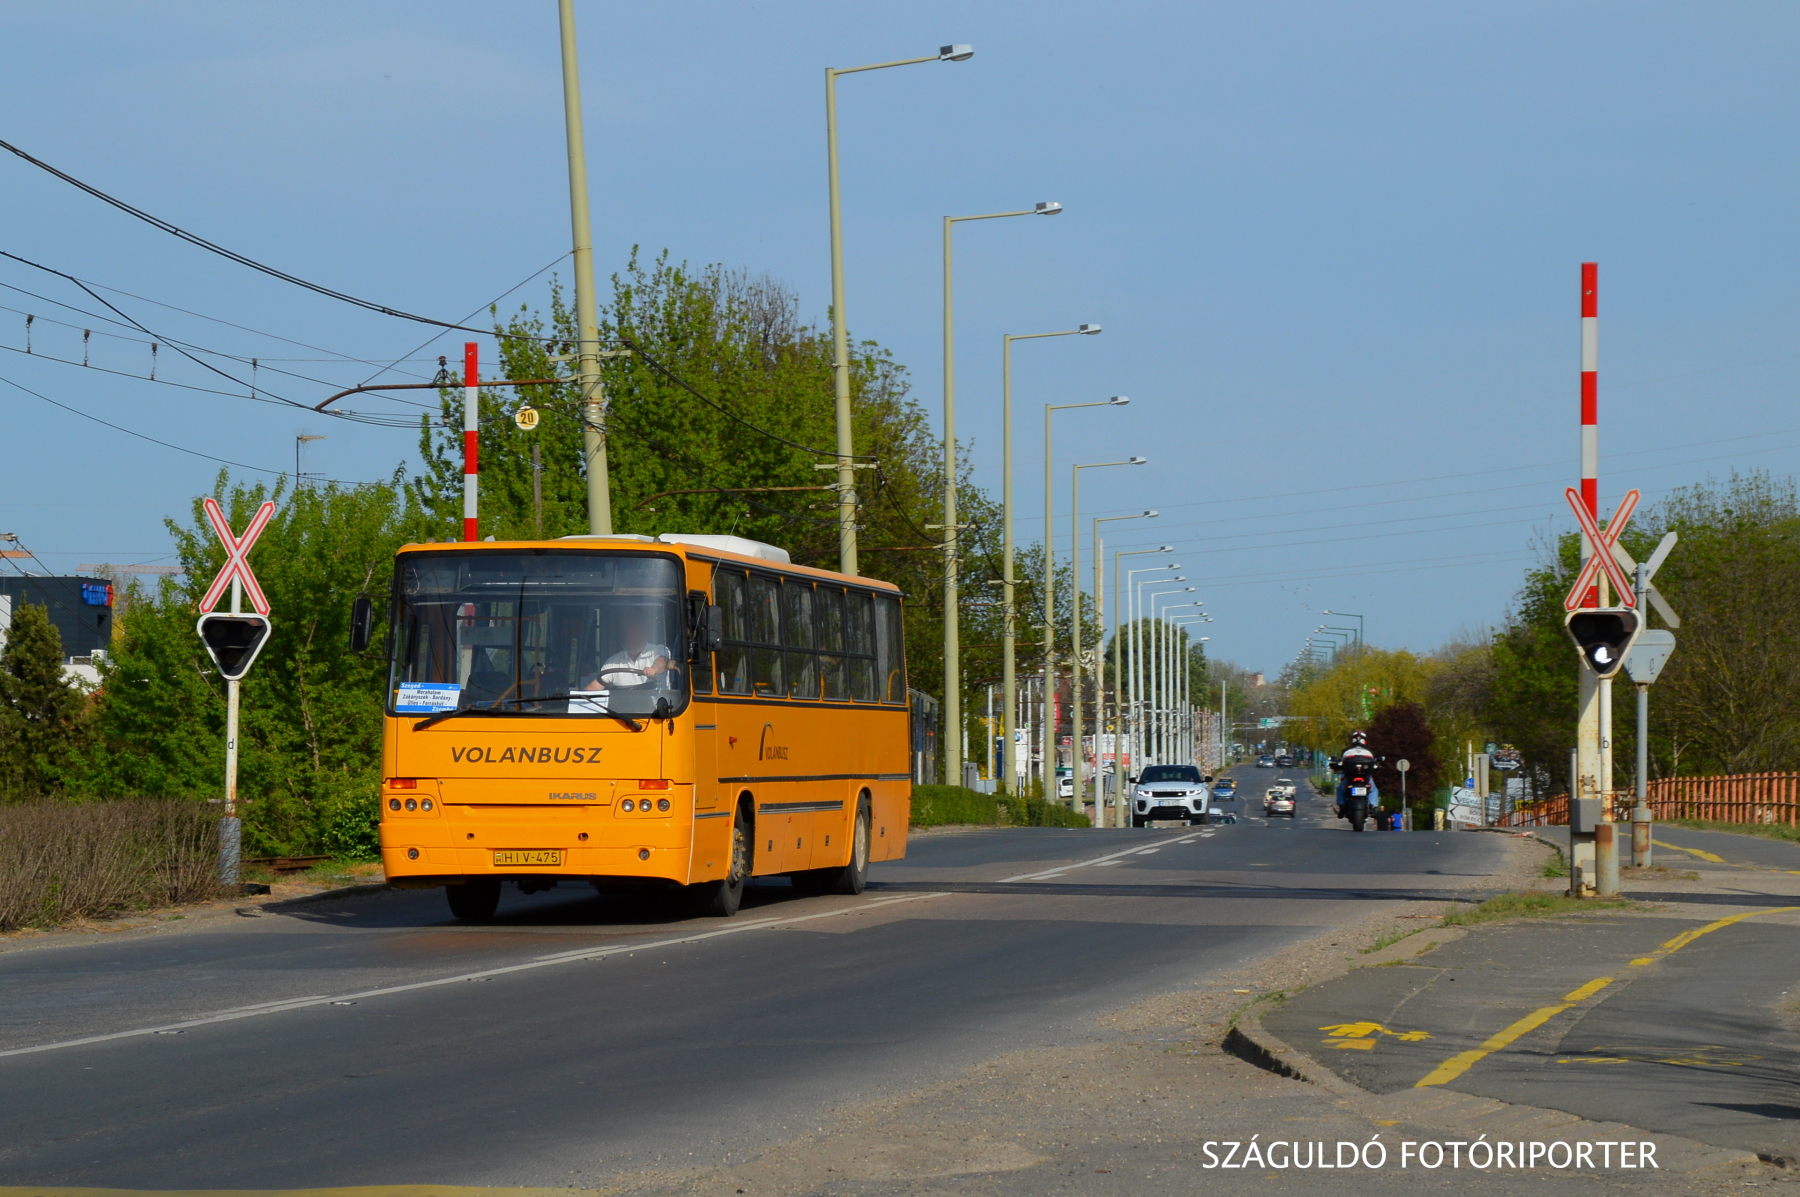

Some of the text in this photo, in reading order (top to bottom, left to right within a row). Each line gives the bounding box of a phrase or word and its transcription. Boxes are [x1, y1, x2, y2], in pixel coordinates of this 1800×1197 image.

[520, 412, 534, 424] 20
[452, 746, 603, 764] VOLÁNBUSZ
[504, 852, 558, 863] HIV-475
